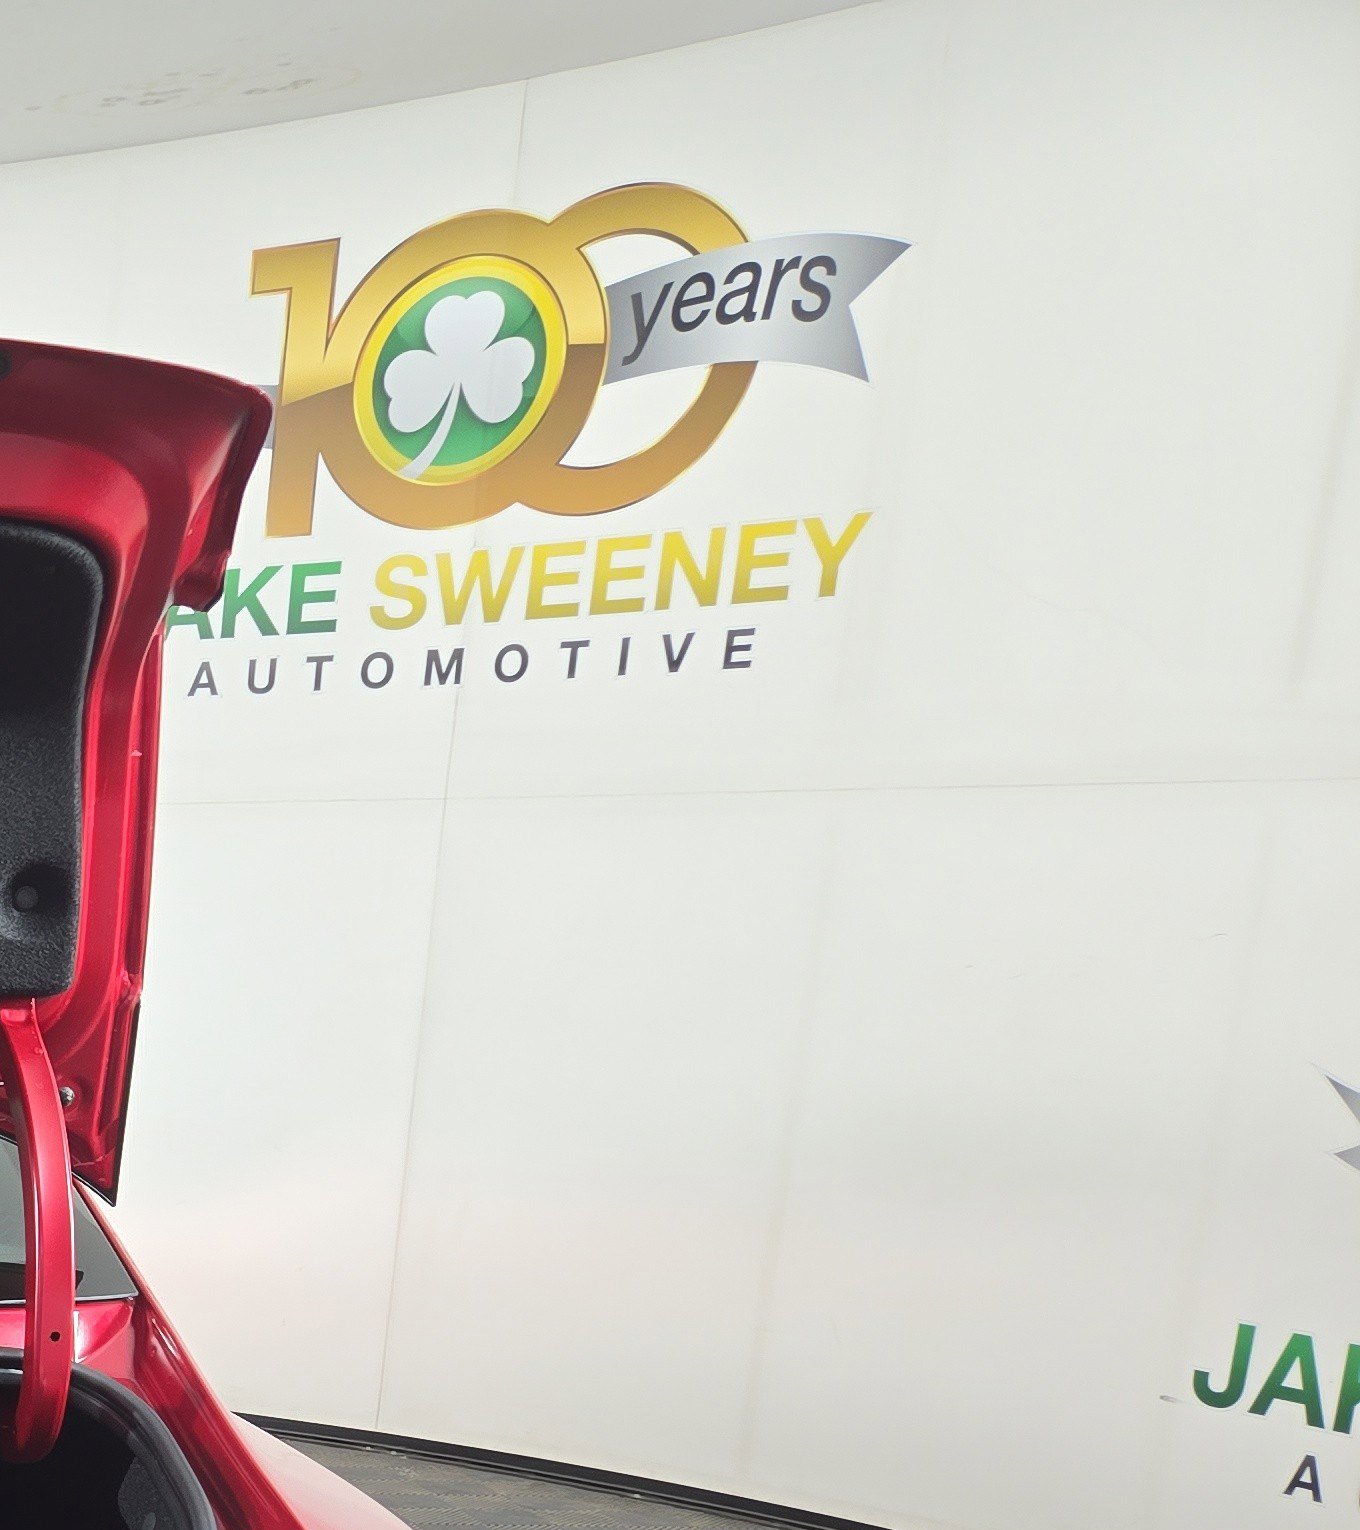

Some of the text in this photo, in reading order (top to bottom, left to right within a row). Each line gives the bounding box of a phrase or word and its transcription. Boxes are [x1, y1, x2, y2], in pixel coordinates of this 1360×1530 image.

[250, 182, 758, 539] 100
[621, 252, 837, 365] years
[369, 511, 874, 632] SWEENEY
[187, 628, 757, 698] AUTOMOTIVE
